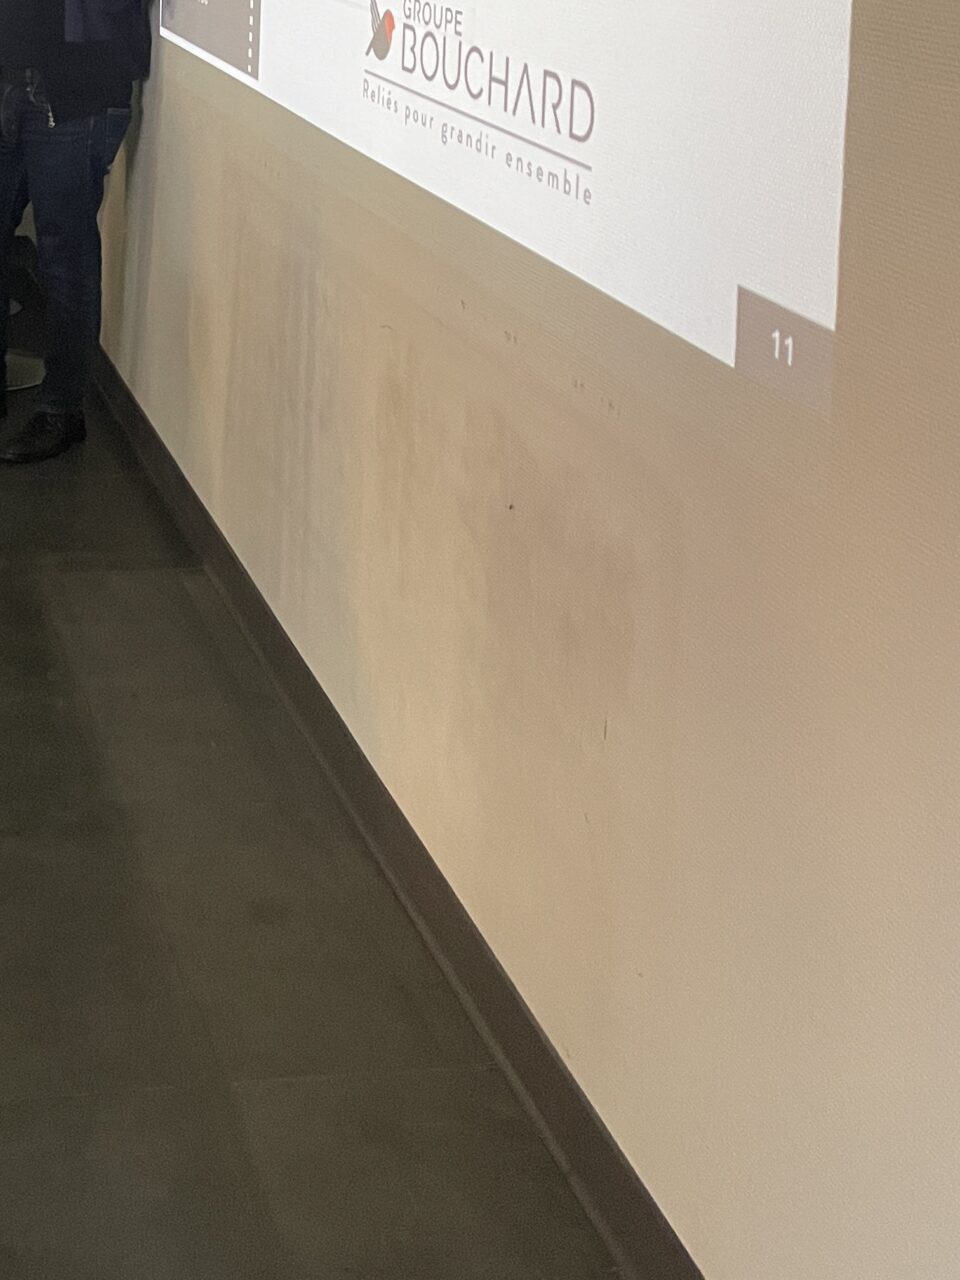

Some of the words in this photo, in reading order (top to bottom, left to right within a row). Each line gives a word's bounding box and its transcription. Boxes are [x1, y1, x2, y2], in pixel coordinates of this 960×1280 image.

[362, 78, 398, 114] Reliés
[405, 105, 434, 129] pour
[441, 122, 496, 160] grandir
[505, 151, 592, 205] ensemble
[401, 23, 595, 143] BOUCHARD
[771, 329, 793, 366] 11
